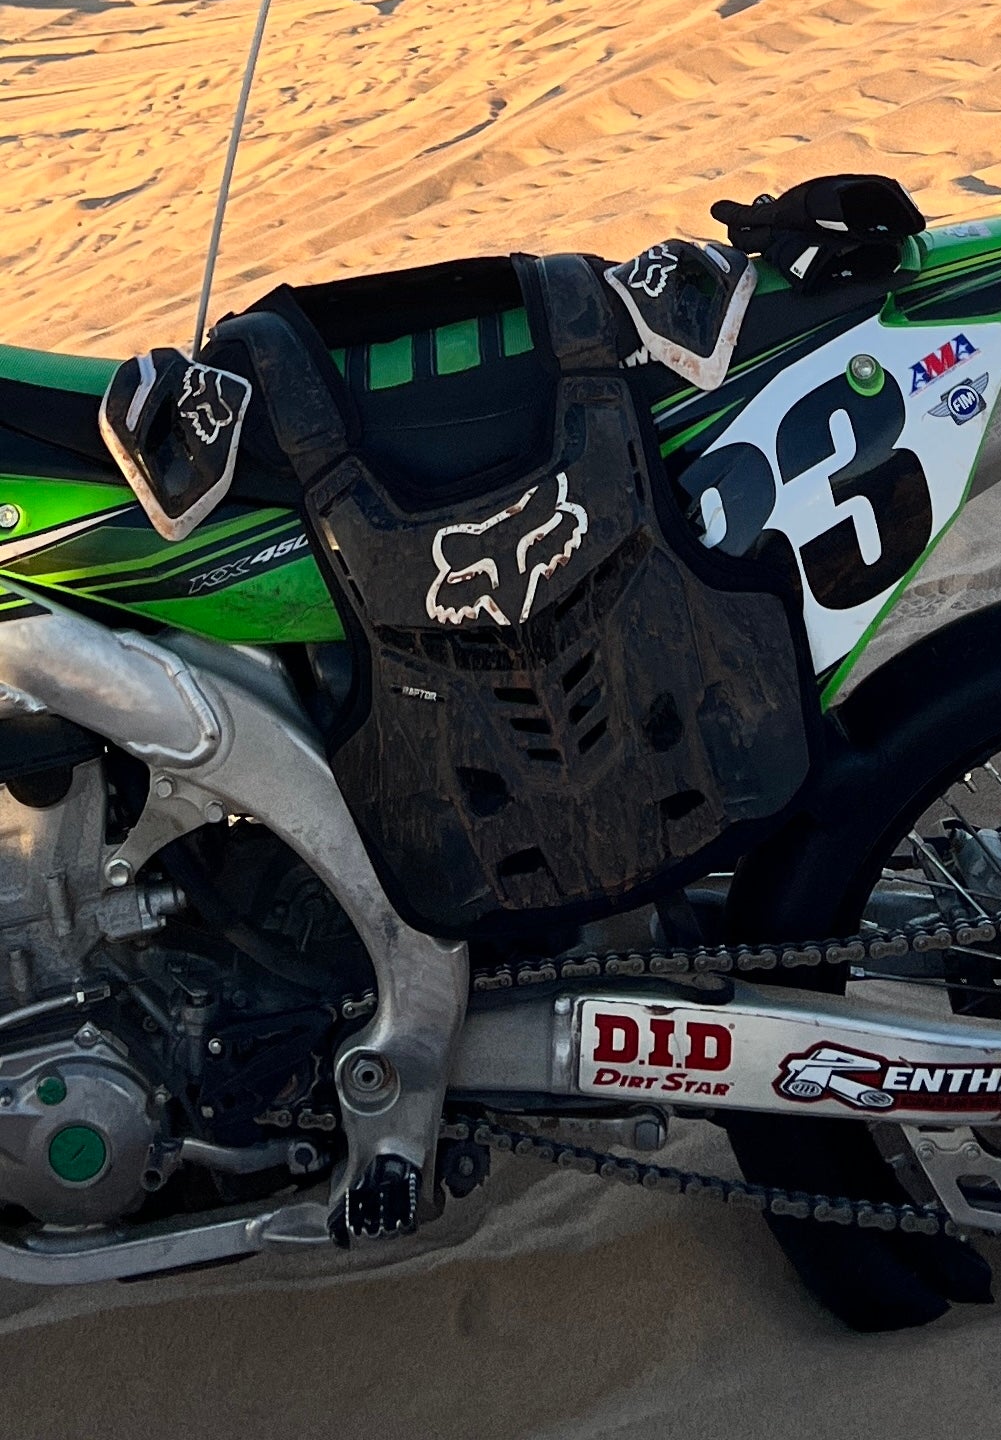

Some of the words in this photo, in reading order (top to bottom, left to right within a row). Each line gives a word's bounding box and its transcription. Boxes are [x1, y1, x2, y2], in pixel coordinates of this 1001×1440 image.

[908, 333, 980, 397] AMA
[952, 390, 977, 413] FIM
[593, 1013, 732, 1072] D.I.D
[593, 1067, 658, 1090] DIRT
[661, 1072, 731, 1097] STAR
